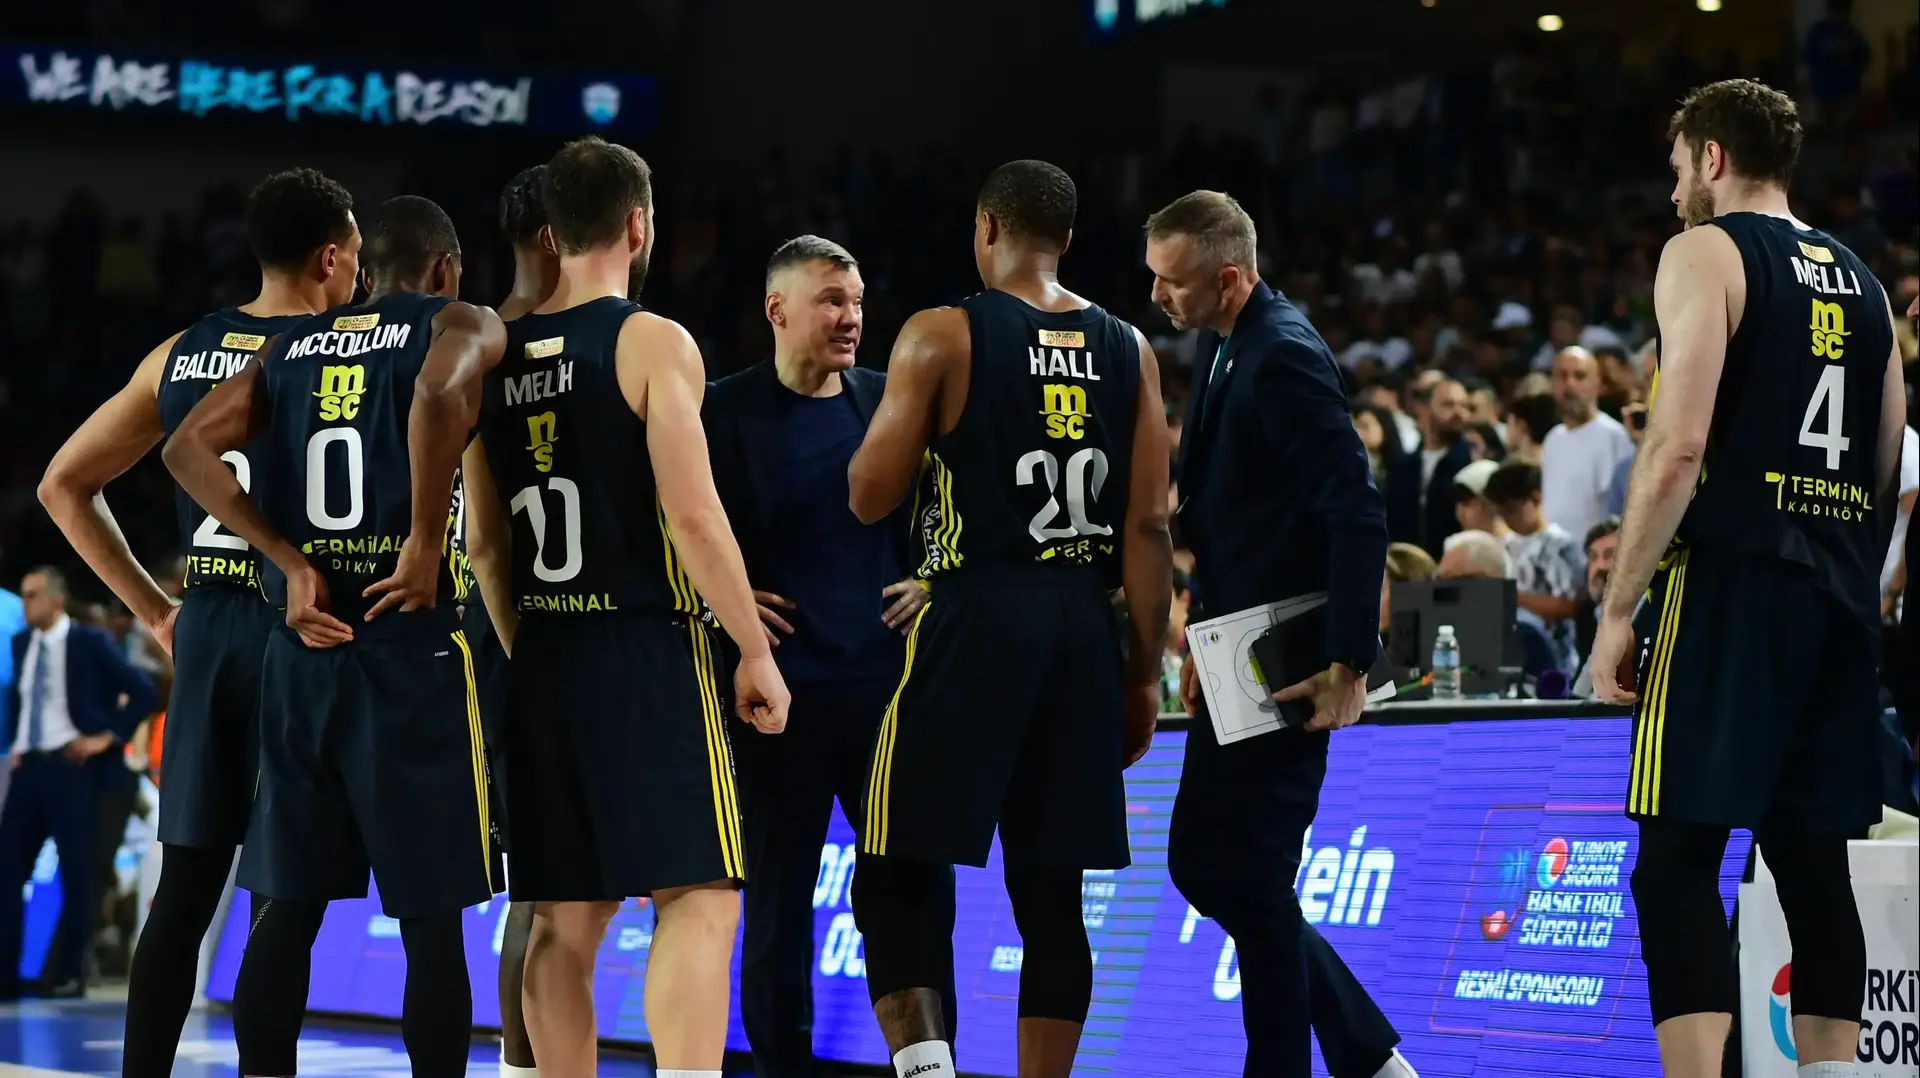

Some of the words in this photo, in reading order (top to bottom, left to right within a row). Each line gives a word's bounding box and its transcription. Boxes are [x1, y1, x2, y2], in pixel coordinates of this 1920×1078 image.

[19, 50, 88, 102] WE
[90, 54, 176, 110] ARE
[394, 71, 532, 126] REASON
[1790, 256, 1862, 296] MELLI
[284, 323, 412, 361] MCCOLLUM
[1028, 346, 1101, 381] HALL
[1798, 364, 1850, 470] 4
[306, 426, 364, 531] 0
[1015, 447, 1113, 544] 20
[510, 476, 583, 583] 10
